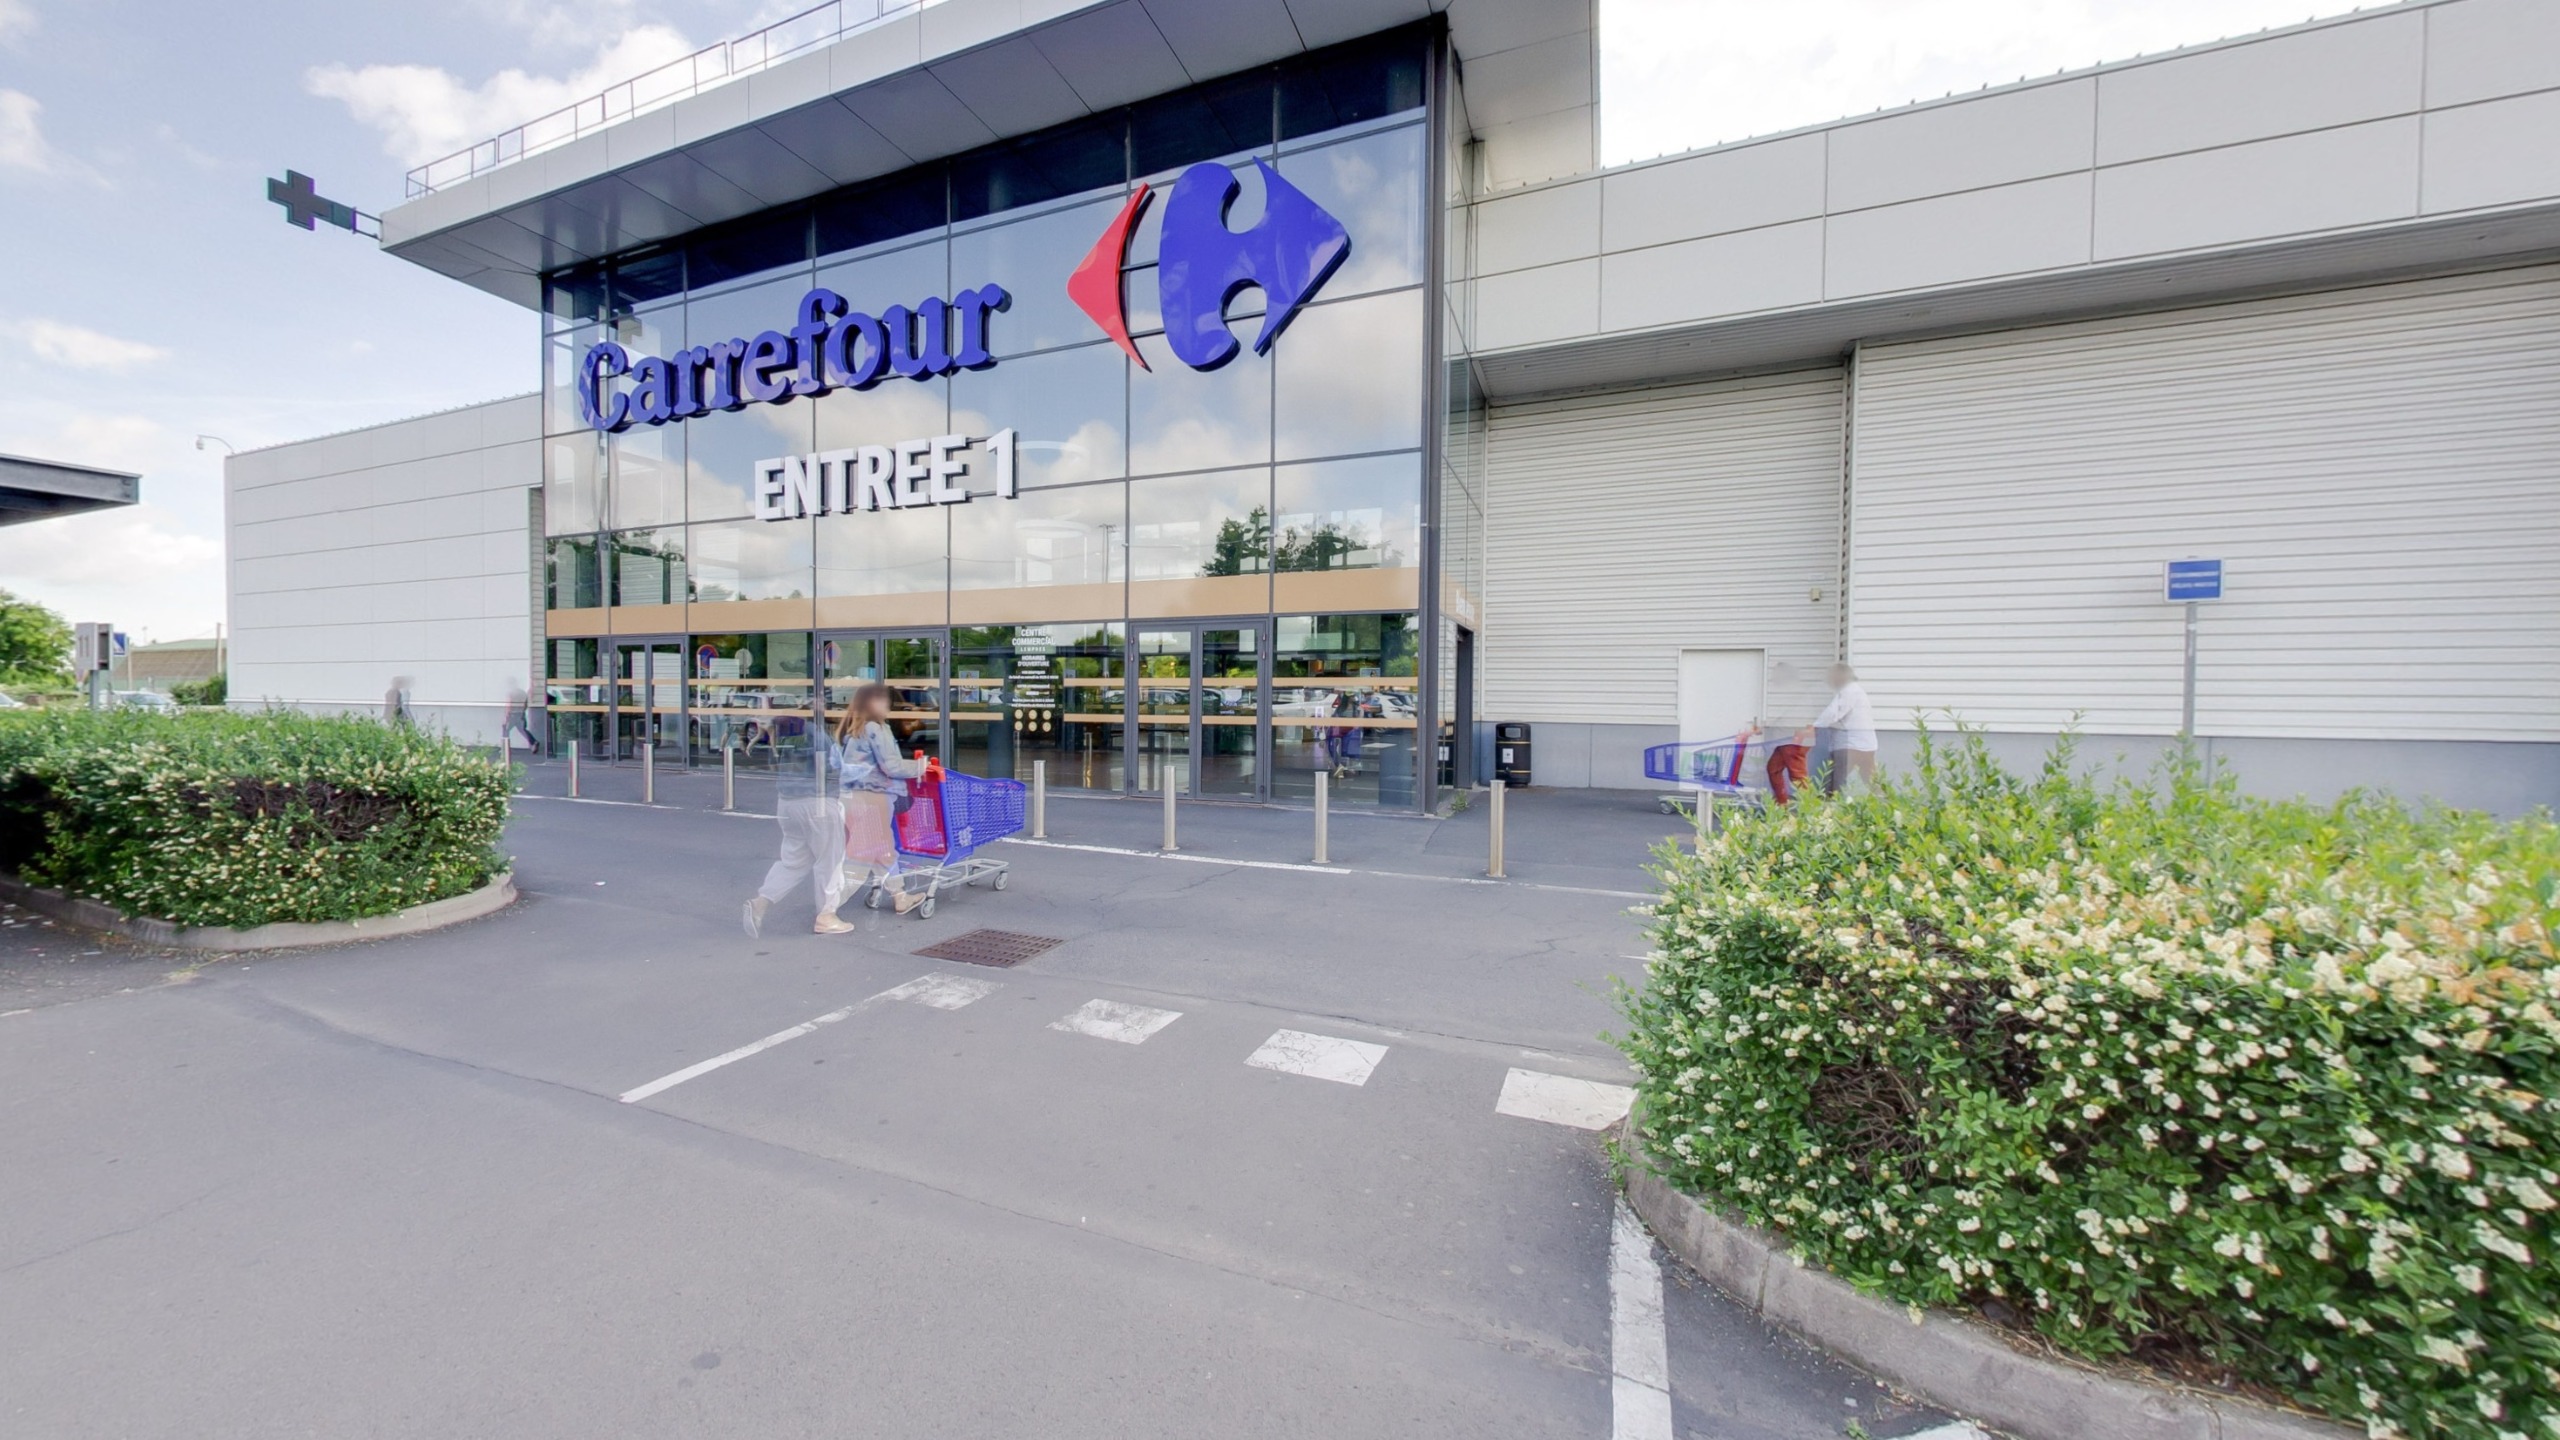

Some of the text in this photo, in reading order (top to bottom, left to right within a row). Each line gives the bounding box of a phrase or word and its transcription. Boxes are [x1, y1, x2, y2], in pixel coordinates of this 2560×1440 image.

[578, 282, 1012, 432] Carrefour
[754, 427, 1018, 520] ENTREE 1
[1021, 628, 1046, 636] CENTRE
